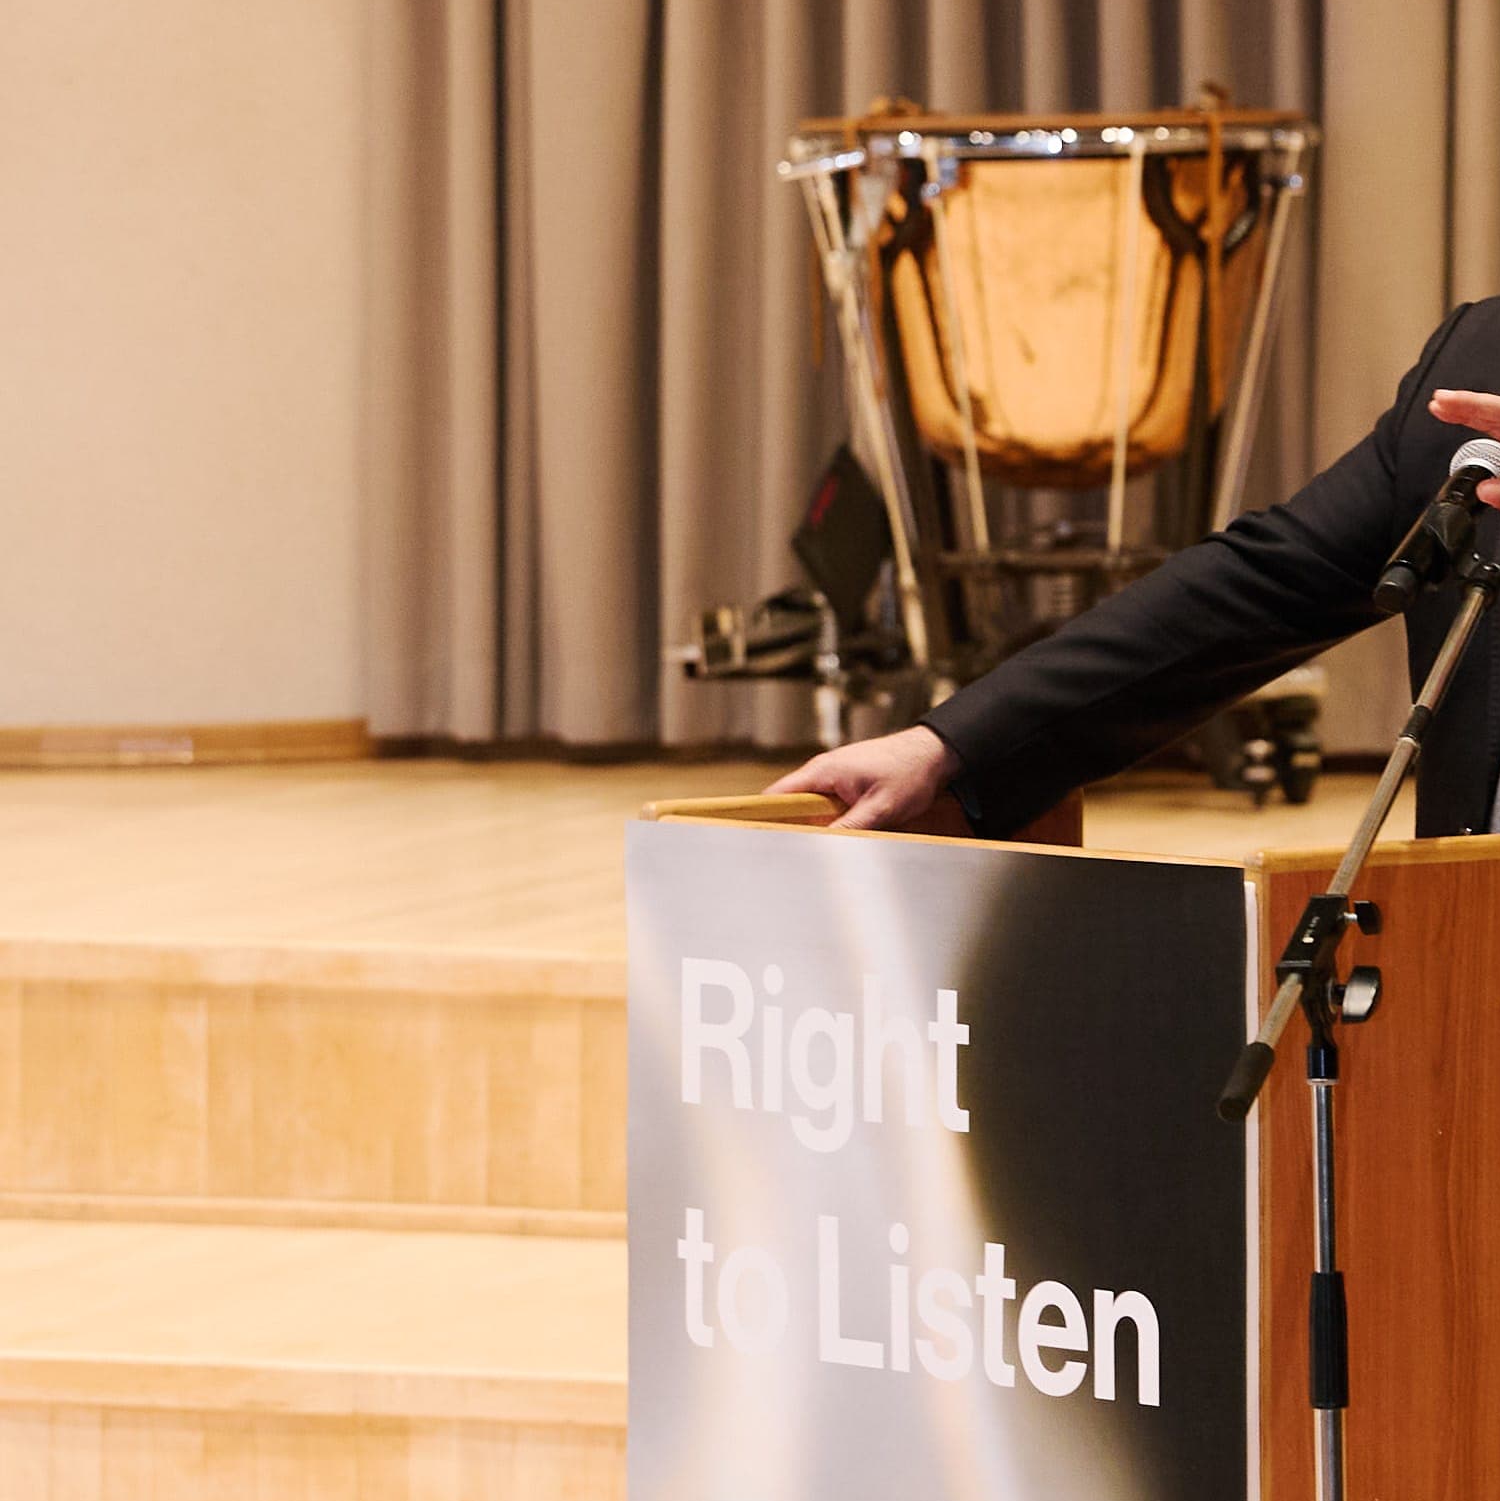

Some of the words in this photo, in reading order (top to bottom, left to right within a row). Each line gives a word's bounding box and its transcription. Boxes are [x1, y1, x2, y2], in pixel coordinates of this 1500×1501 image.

[681, 956, 969, 1153] Right
[677, 1206, 788, 1357] to
[817, 1214, 1160, 1407] Listen
